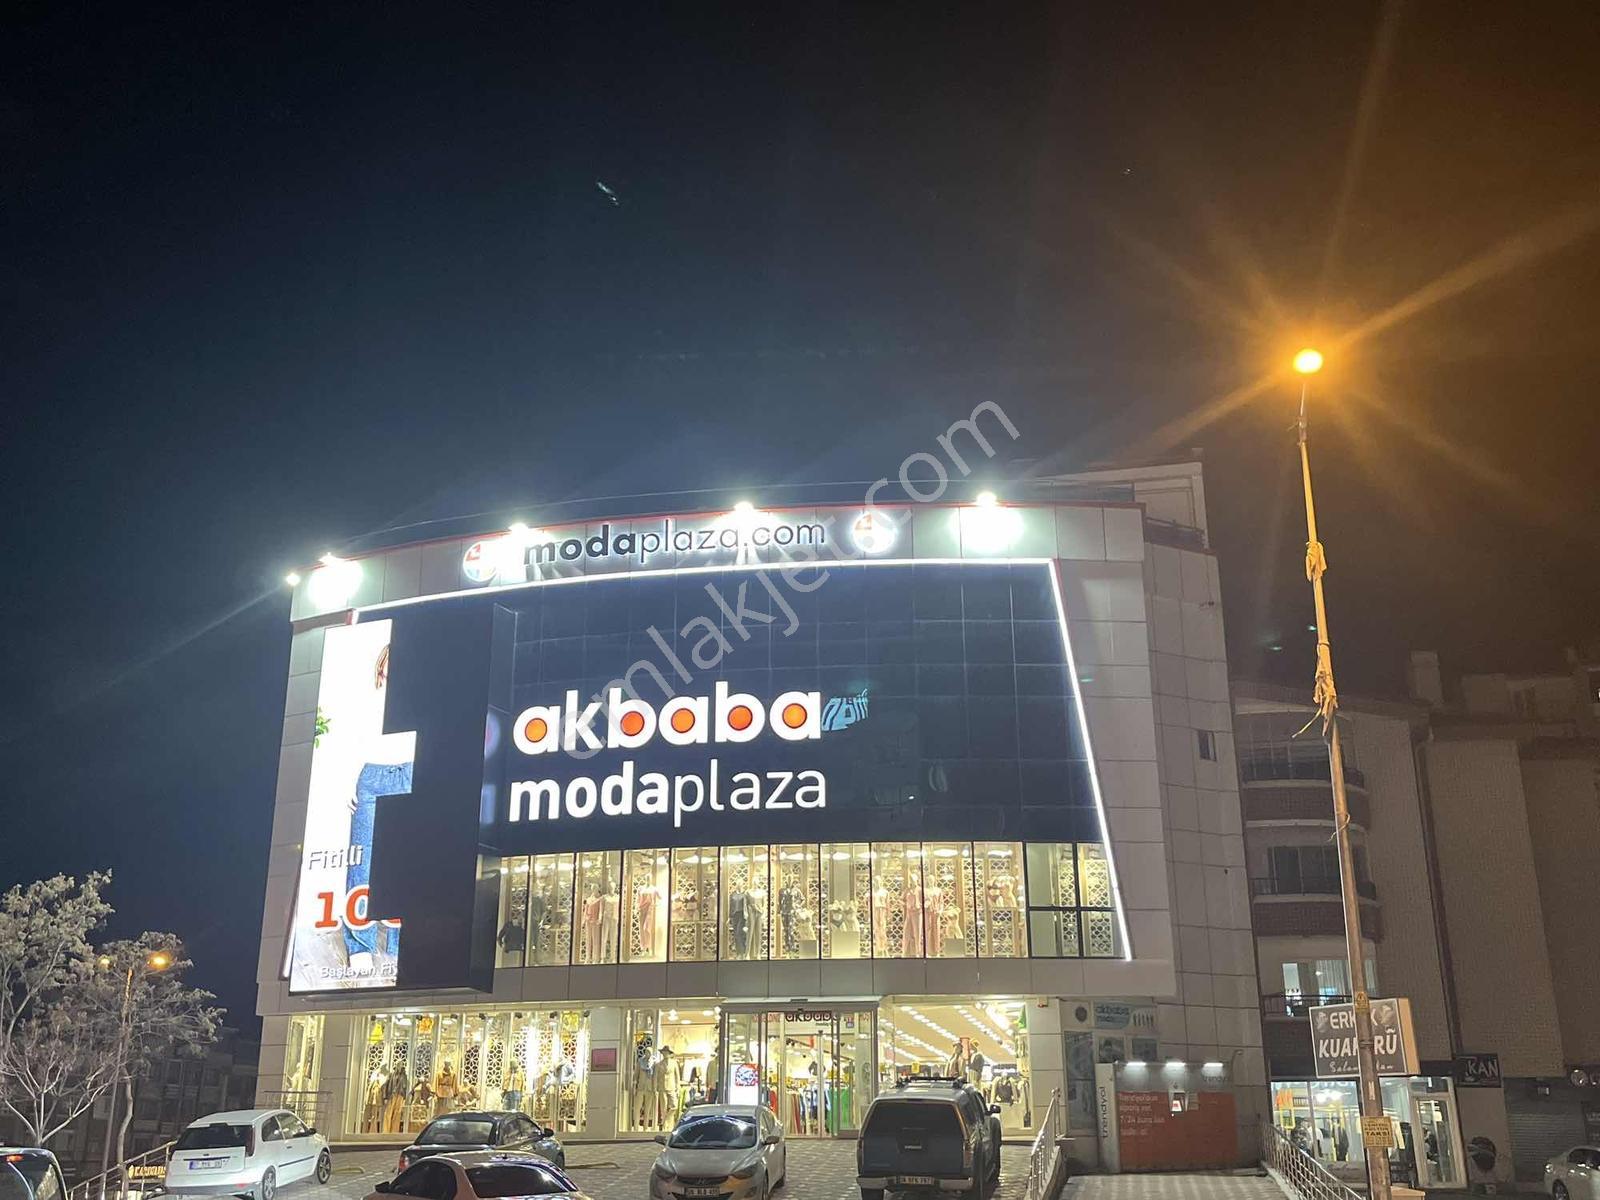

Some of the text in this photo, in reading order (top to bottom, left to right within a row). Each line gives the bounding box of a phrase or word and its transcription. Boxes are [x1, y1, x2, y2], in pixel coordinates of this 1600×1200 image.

[523, 518, 826, 566] modaplaza.com
[513, 681, 822, 755] akbaba
[508, 758, 827, 828] modaplaza
[309, 844, 364, 870] Fitilli
[1330, 1007, 1378, 1029] ERKK
